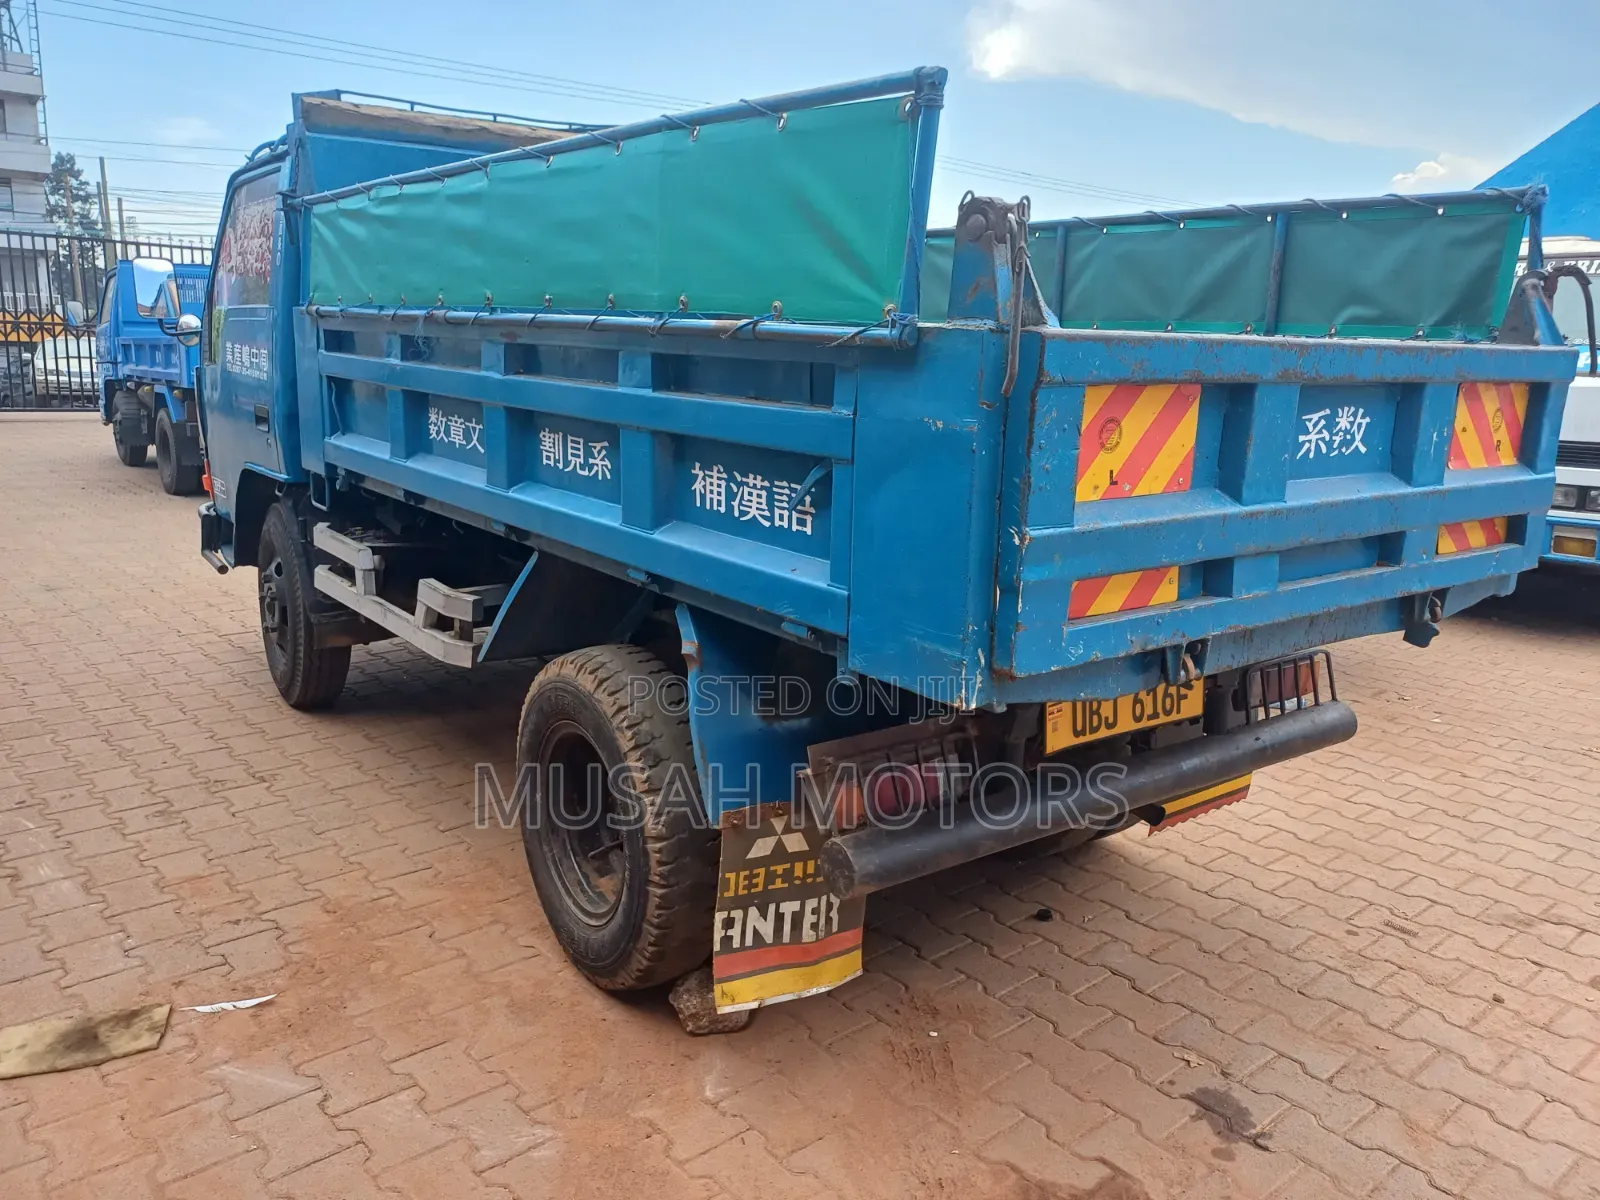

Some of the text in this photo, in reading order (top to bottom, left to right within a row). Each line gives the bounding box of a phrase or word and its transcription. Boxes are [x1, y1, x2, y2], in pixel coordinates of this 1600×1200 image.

[428, 406, 485, 454] 数章文
[539, 427, 612, 481] 割見系
[1296, 405, 1371, 460] 系数
[1495, 439, 1502, 453] R
[1109, 469, 1118, 485] L
[1072, 682, 1194, 738] UBJ 616F
